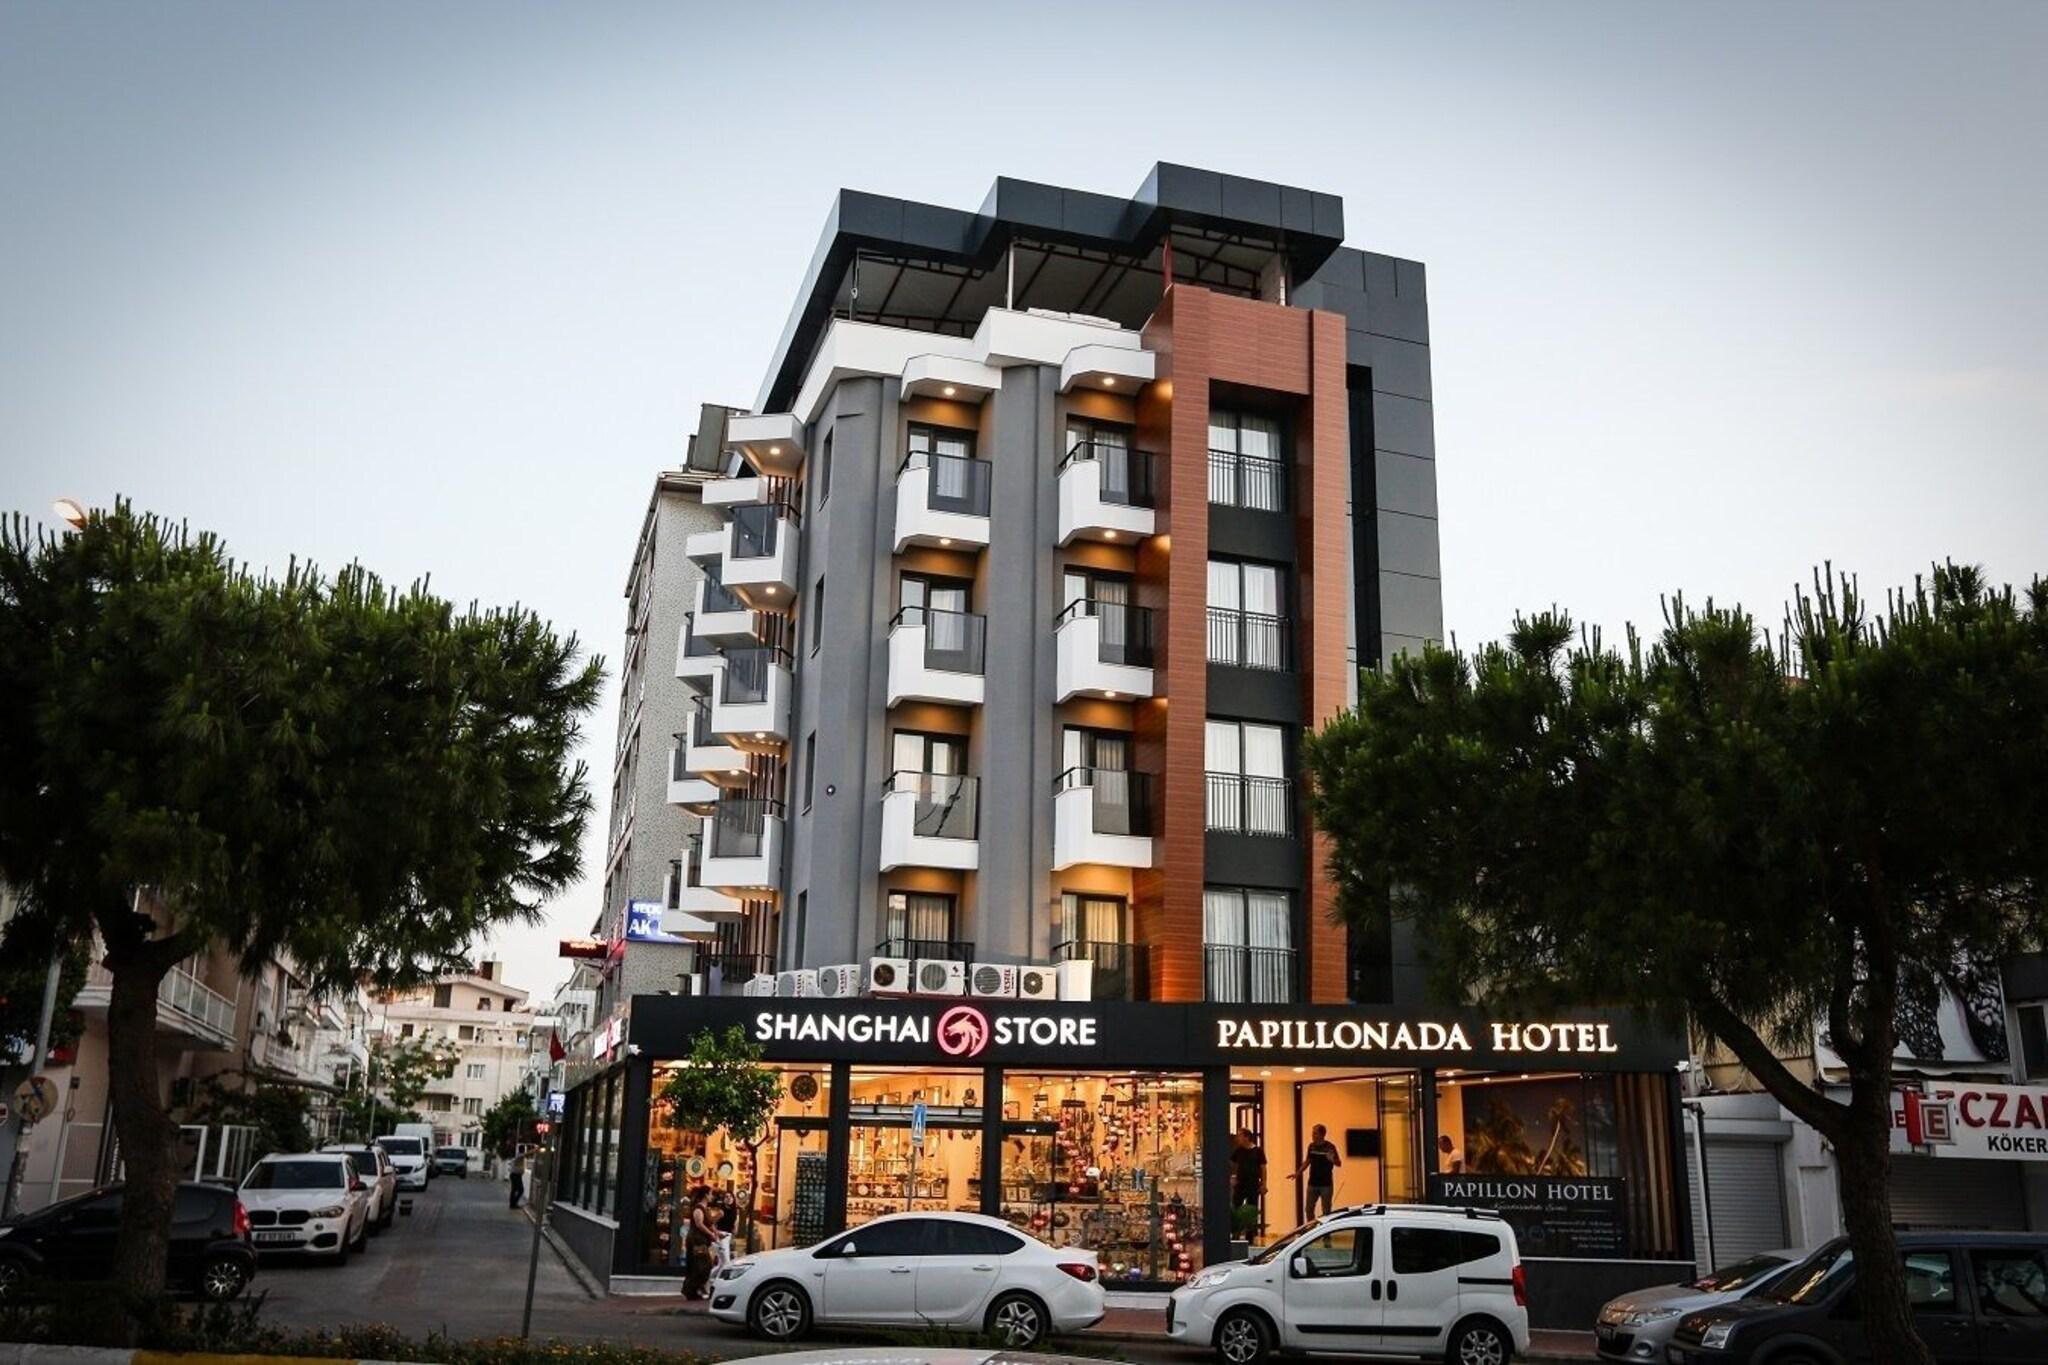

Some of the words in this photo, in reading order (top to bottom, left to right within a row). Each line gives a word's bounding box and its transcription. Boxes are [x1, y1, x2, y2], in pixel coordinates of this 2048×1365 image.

[755, 1012, 929, 1043] SHANGHAI
[994, 1016, 1097, 1045] STORE
[1217, 1020, 1472, 1051] PAPILLONADA
[1491, 1023, 1618, 1052] HOTEL
[1927, 1109, 1946, 1135] E
[1987, 1132, 2048, 1153] KÖKER
[1443, 1182, 1536, 1199] PAPILLON
[1547, 1184, 1613, 1201] HOTEL
